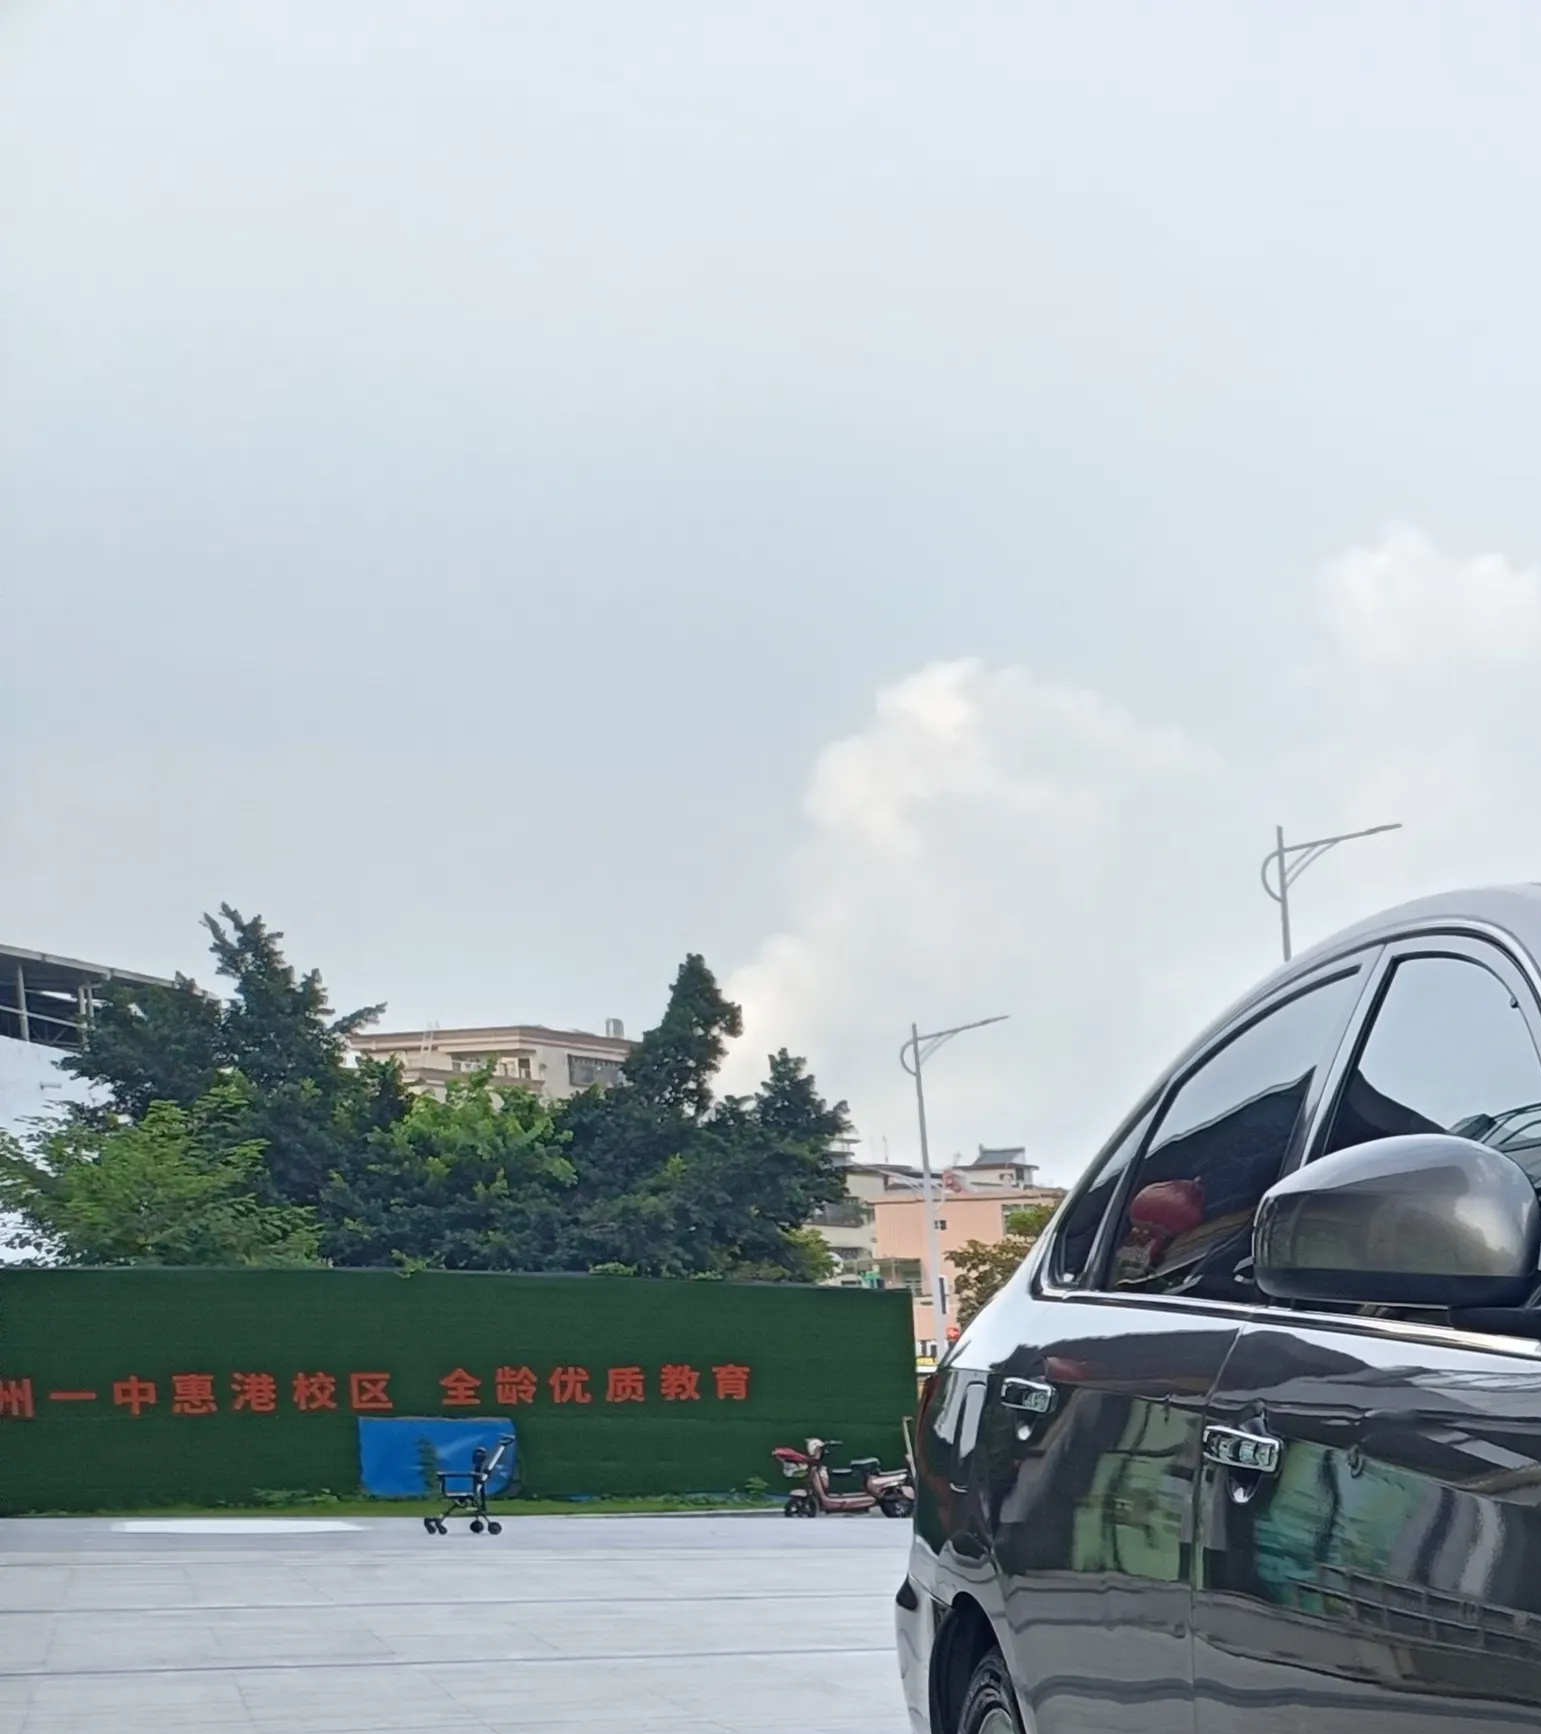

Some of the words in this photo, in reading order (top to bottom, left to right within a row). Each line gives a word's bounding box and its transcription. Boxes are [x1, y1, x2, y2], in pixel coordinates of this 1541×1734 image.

[439, 1364, 750, 1406] 全龄优质教育
